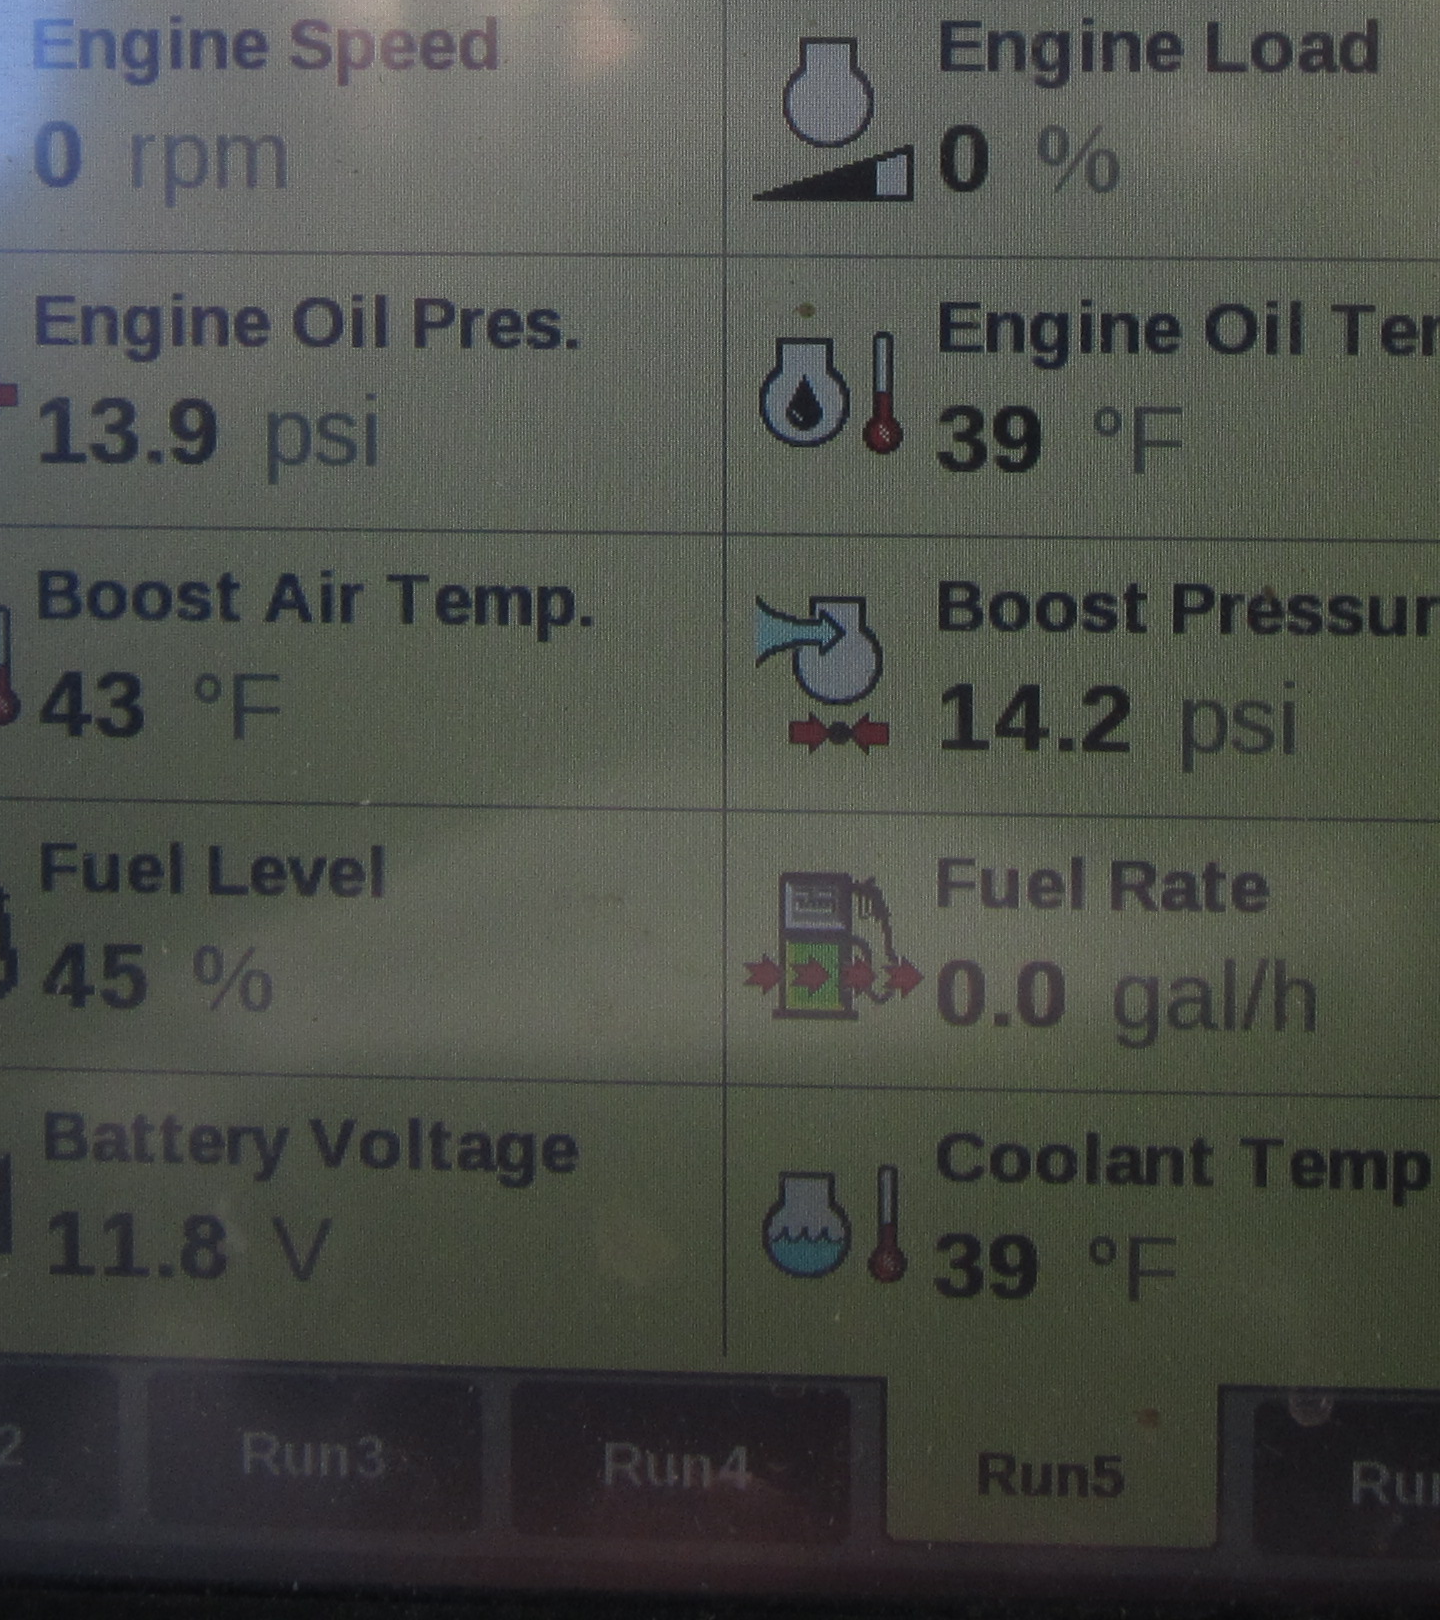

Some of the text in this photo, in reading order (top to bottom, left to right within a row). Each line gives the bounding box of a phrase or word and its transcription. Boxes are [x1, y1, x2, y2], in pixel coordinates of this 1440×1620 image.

[33, 16, 499, 85] Engine Speed
[939, 20, 1380, 89] Engine Load
[33, 120, 289, 207] 0 rpm
[940, 124, 1120, 194] 0 %
[35, 295, 580, 362] Engine Oil Pres.
[938, 302, 1182, 369] Engine
[1205, 302, 1303, 356] Oil
[39, 394, 378, 485] 13.9 psi
[936, 405, 1042, 474] 39
[38, 570, 594, 641] Boost Air Temp.
[937, 581, 1147, 634] Boost
[40, 671, 145, 739] 43
[939, 681, 1296, 772] 14.2 psi
[41, 842, 386, 897] Fuel Level
[937, 857, 1270, 912] Fuel Rate
[43, 944, 273, 1012] 45 %
[937, 958, 1316, 1049] 0.0 gal/h
[44, 1111, 579, 1188] Battery Voltage
[935, 1132, 1431, 1206] Coolant Temp
[47, 1211, 332, 1281] 11.8 V
[934, 1234, 1038, 1299] 39
[243, 1432, 386, 1478] Run3
[604, 1441, 753, 1489] Run4
[977, 1452, 1124, 1498] Run5
